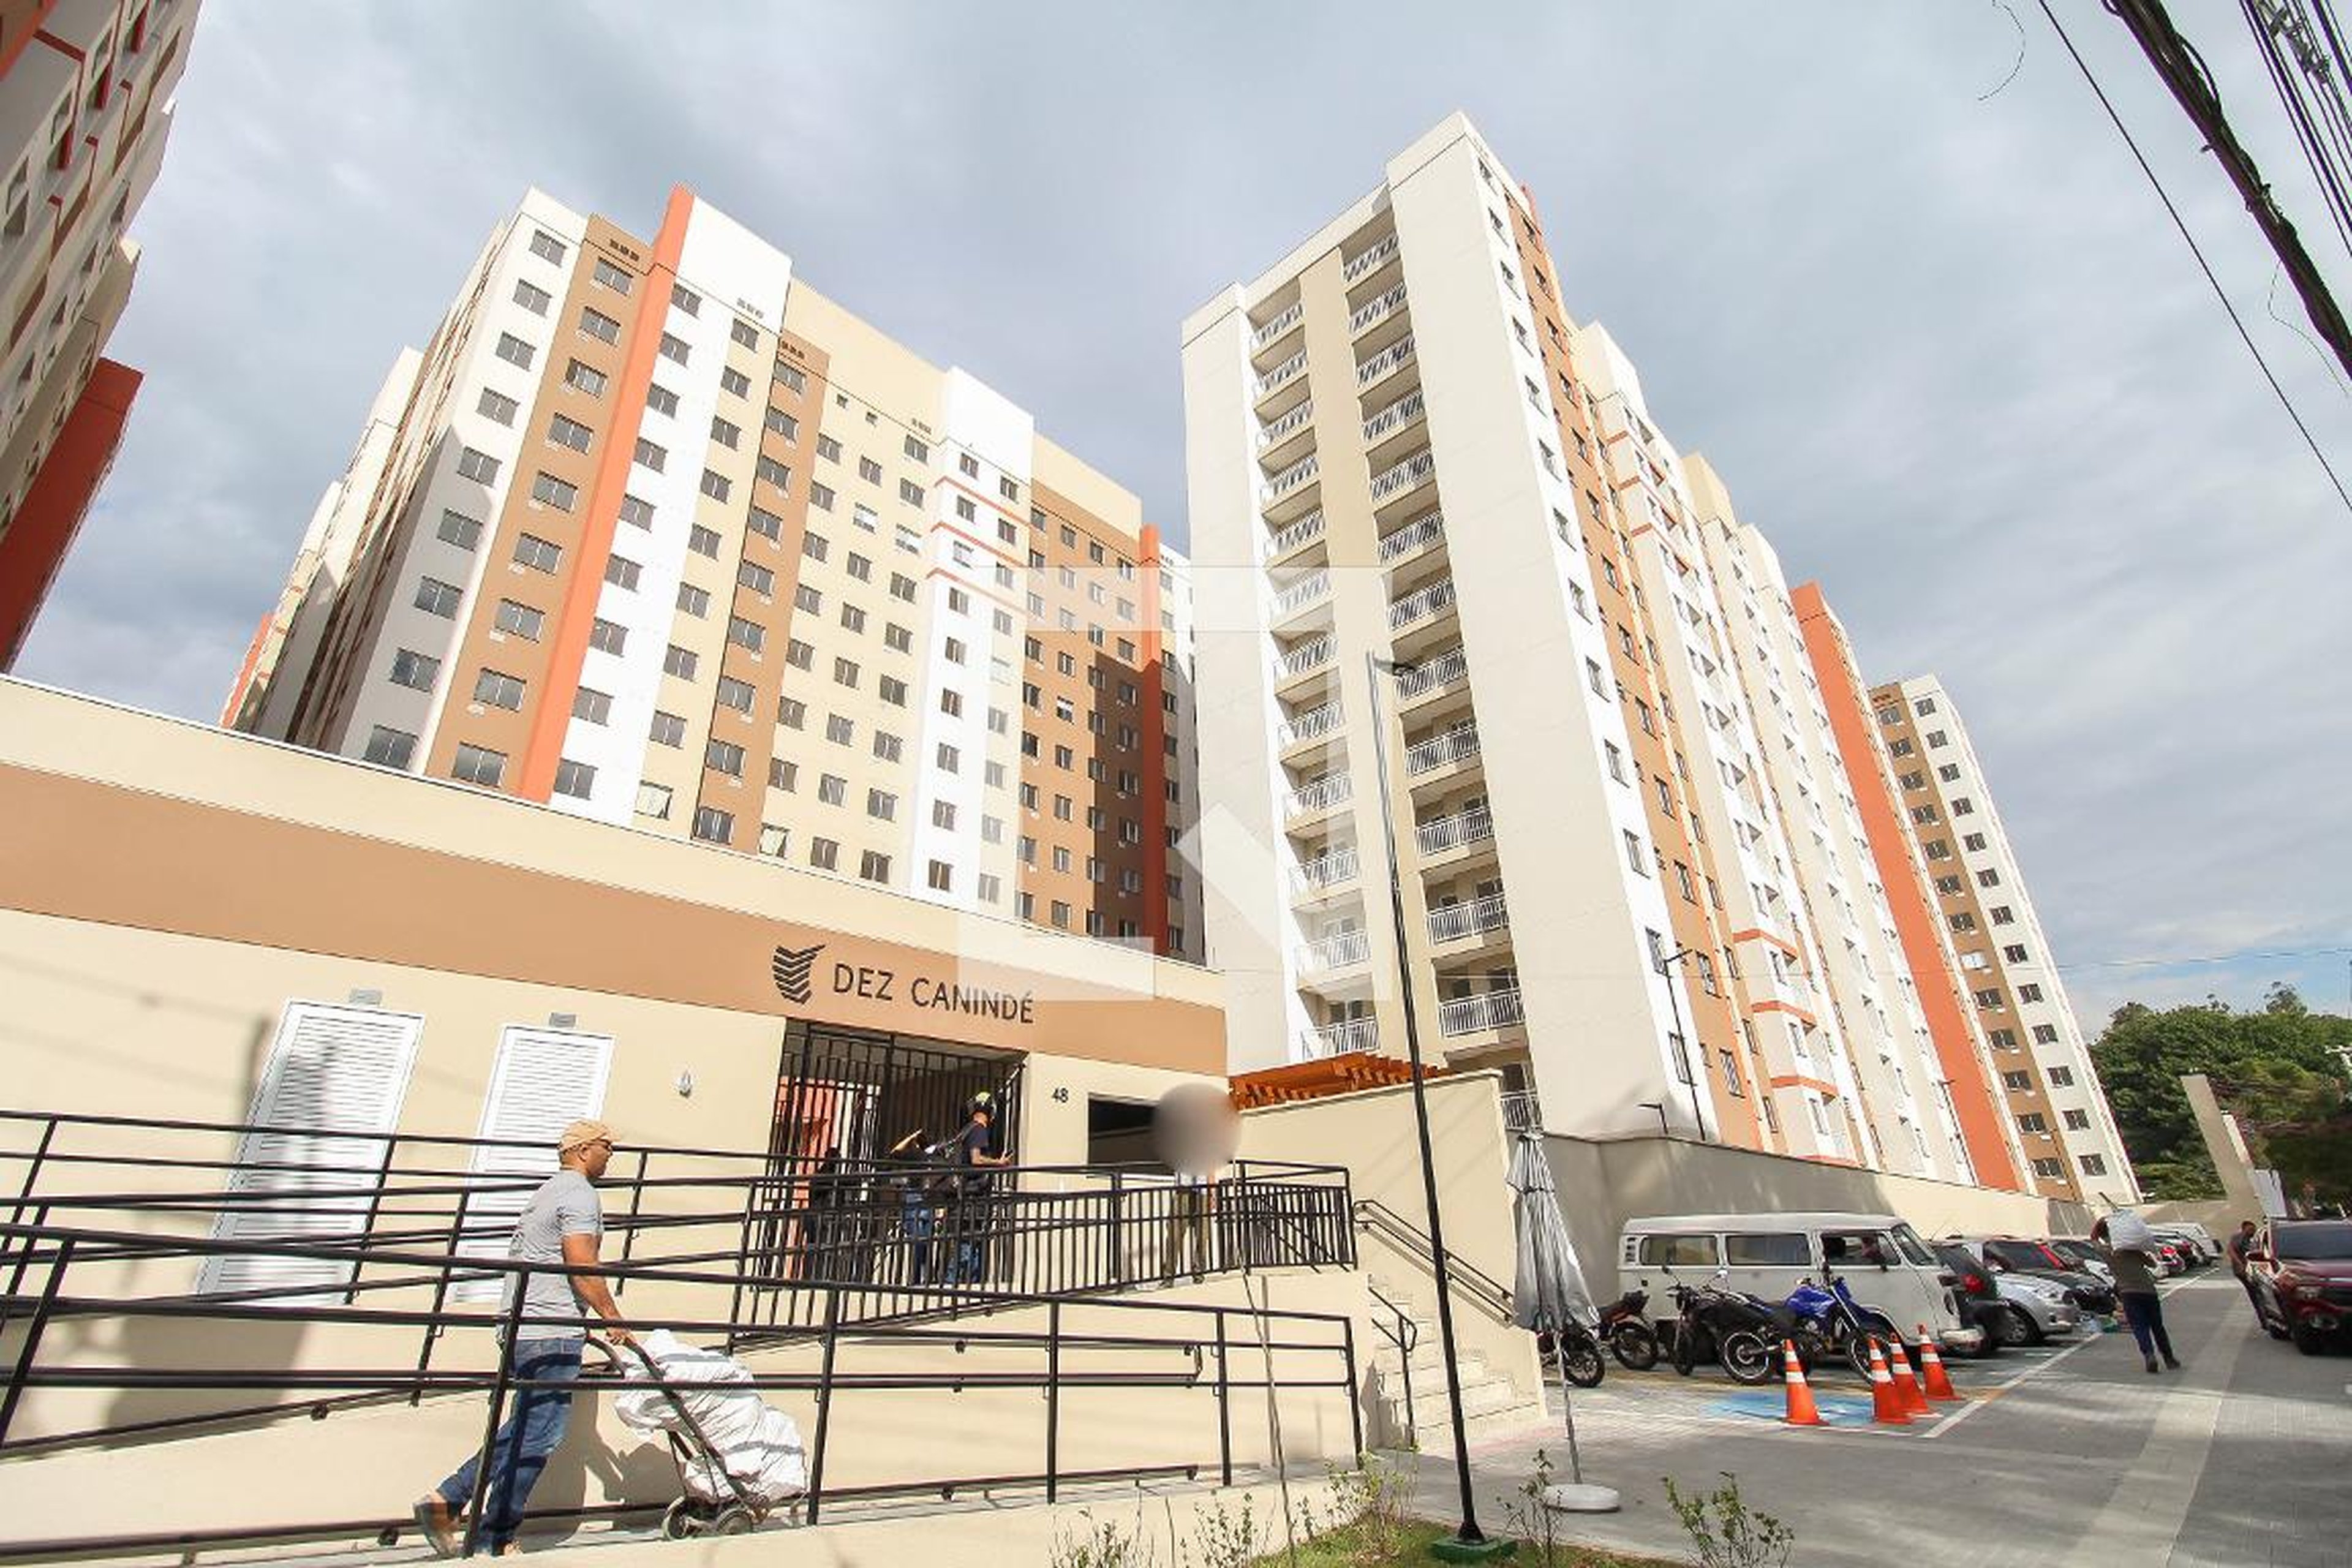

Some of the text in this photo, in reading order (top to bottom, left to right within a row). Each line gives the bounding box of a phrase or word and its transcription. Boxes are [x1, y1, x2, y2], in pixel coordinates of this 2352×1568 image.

[834, 963, 1034, 1024] DEZ CANINDÉ
[1051, 1087, 1069, 1104] 48
